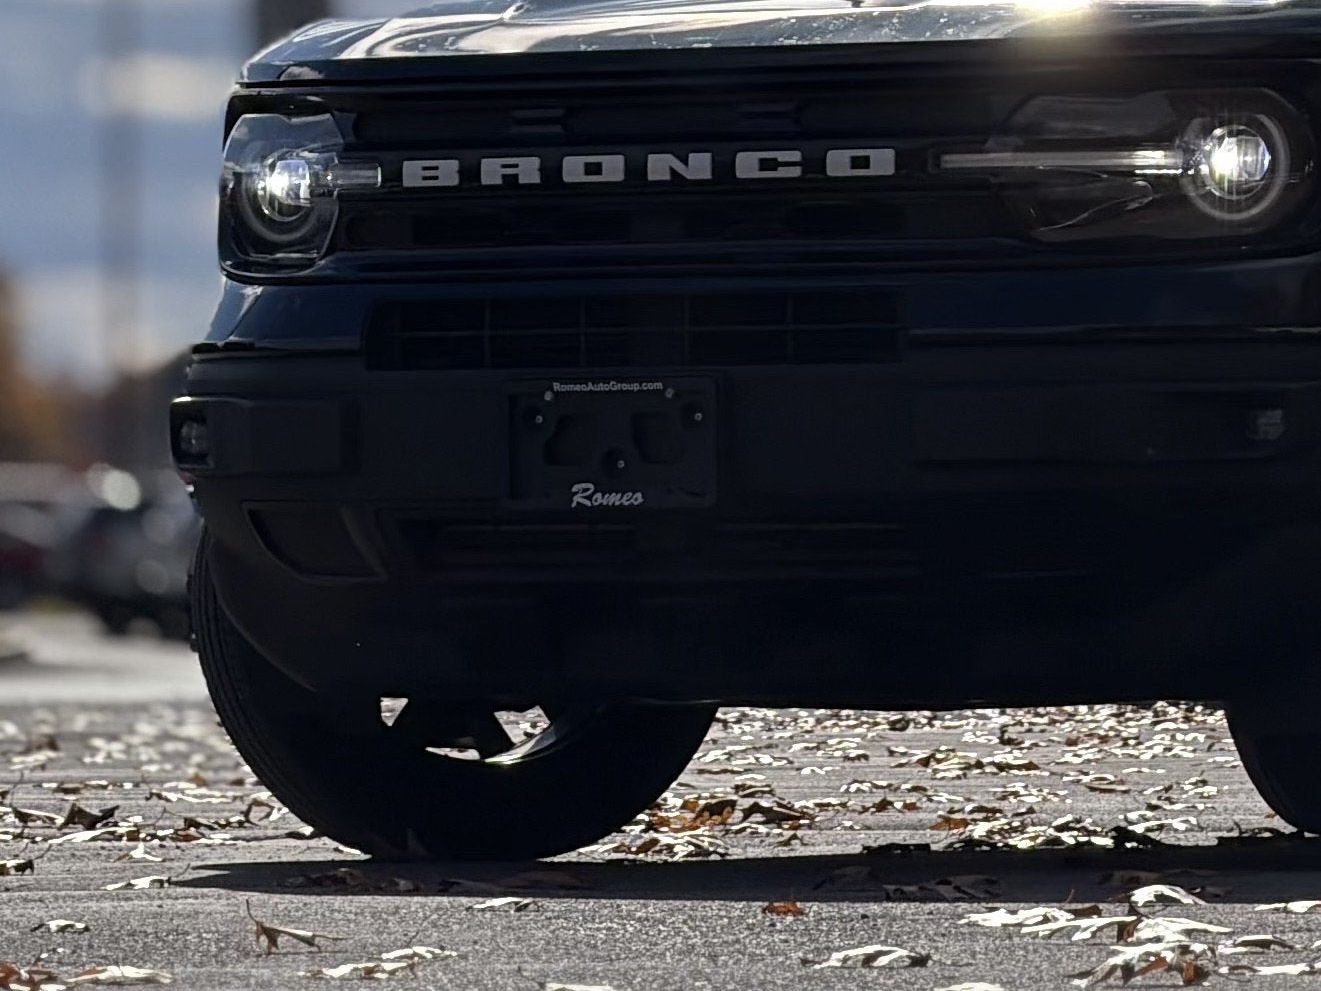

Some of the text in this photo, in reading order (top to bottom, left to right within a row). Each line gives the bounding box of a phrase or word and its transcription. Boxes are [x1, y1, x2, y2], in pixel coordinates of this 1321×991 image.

[402, 147, 896, 188] BRONCO
[553, 381, 663, 392] RomeoAutoGroup.com
[571, 482, 644, 508] Romeo
